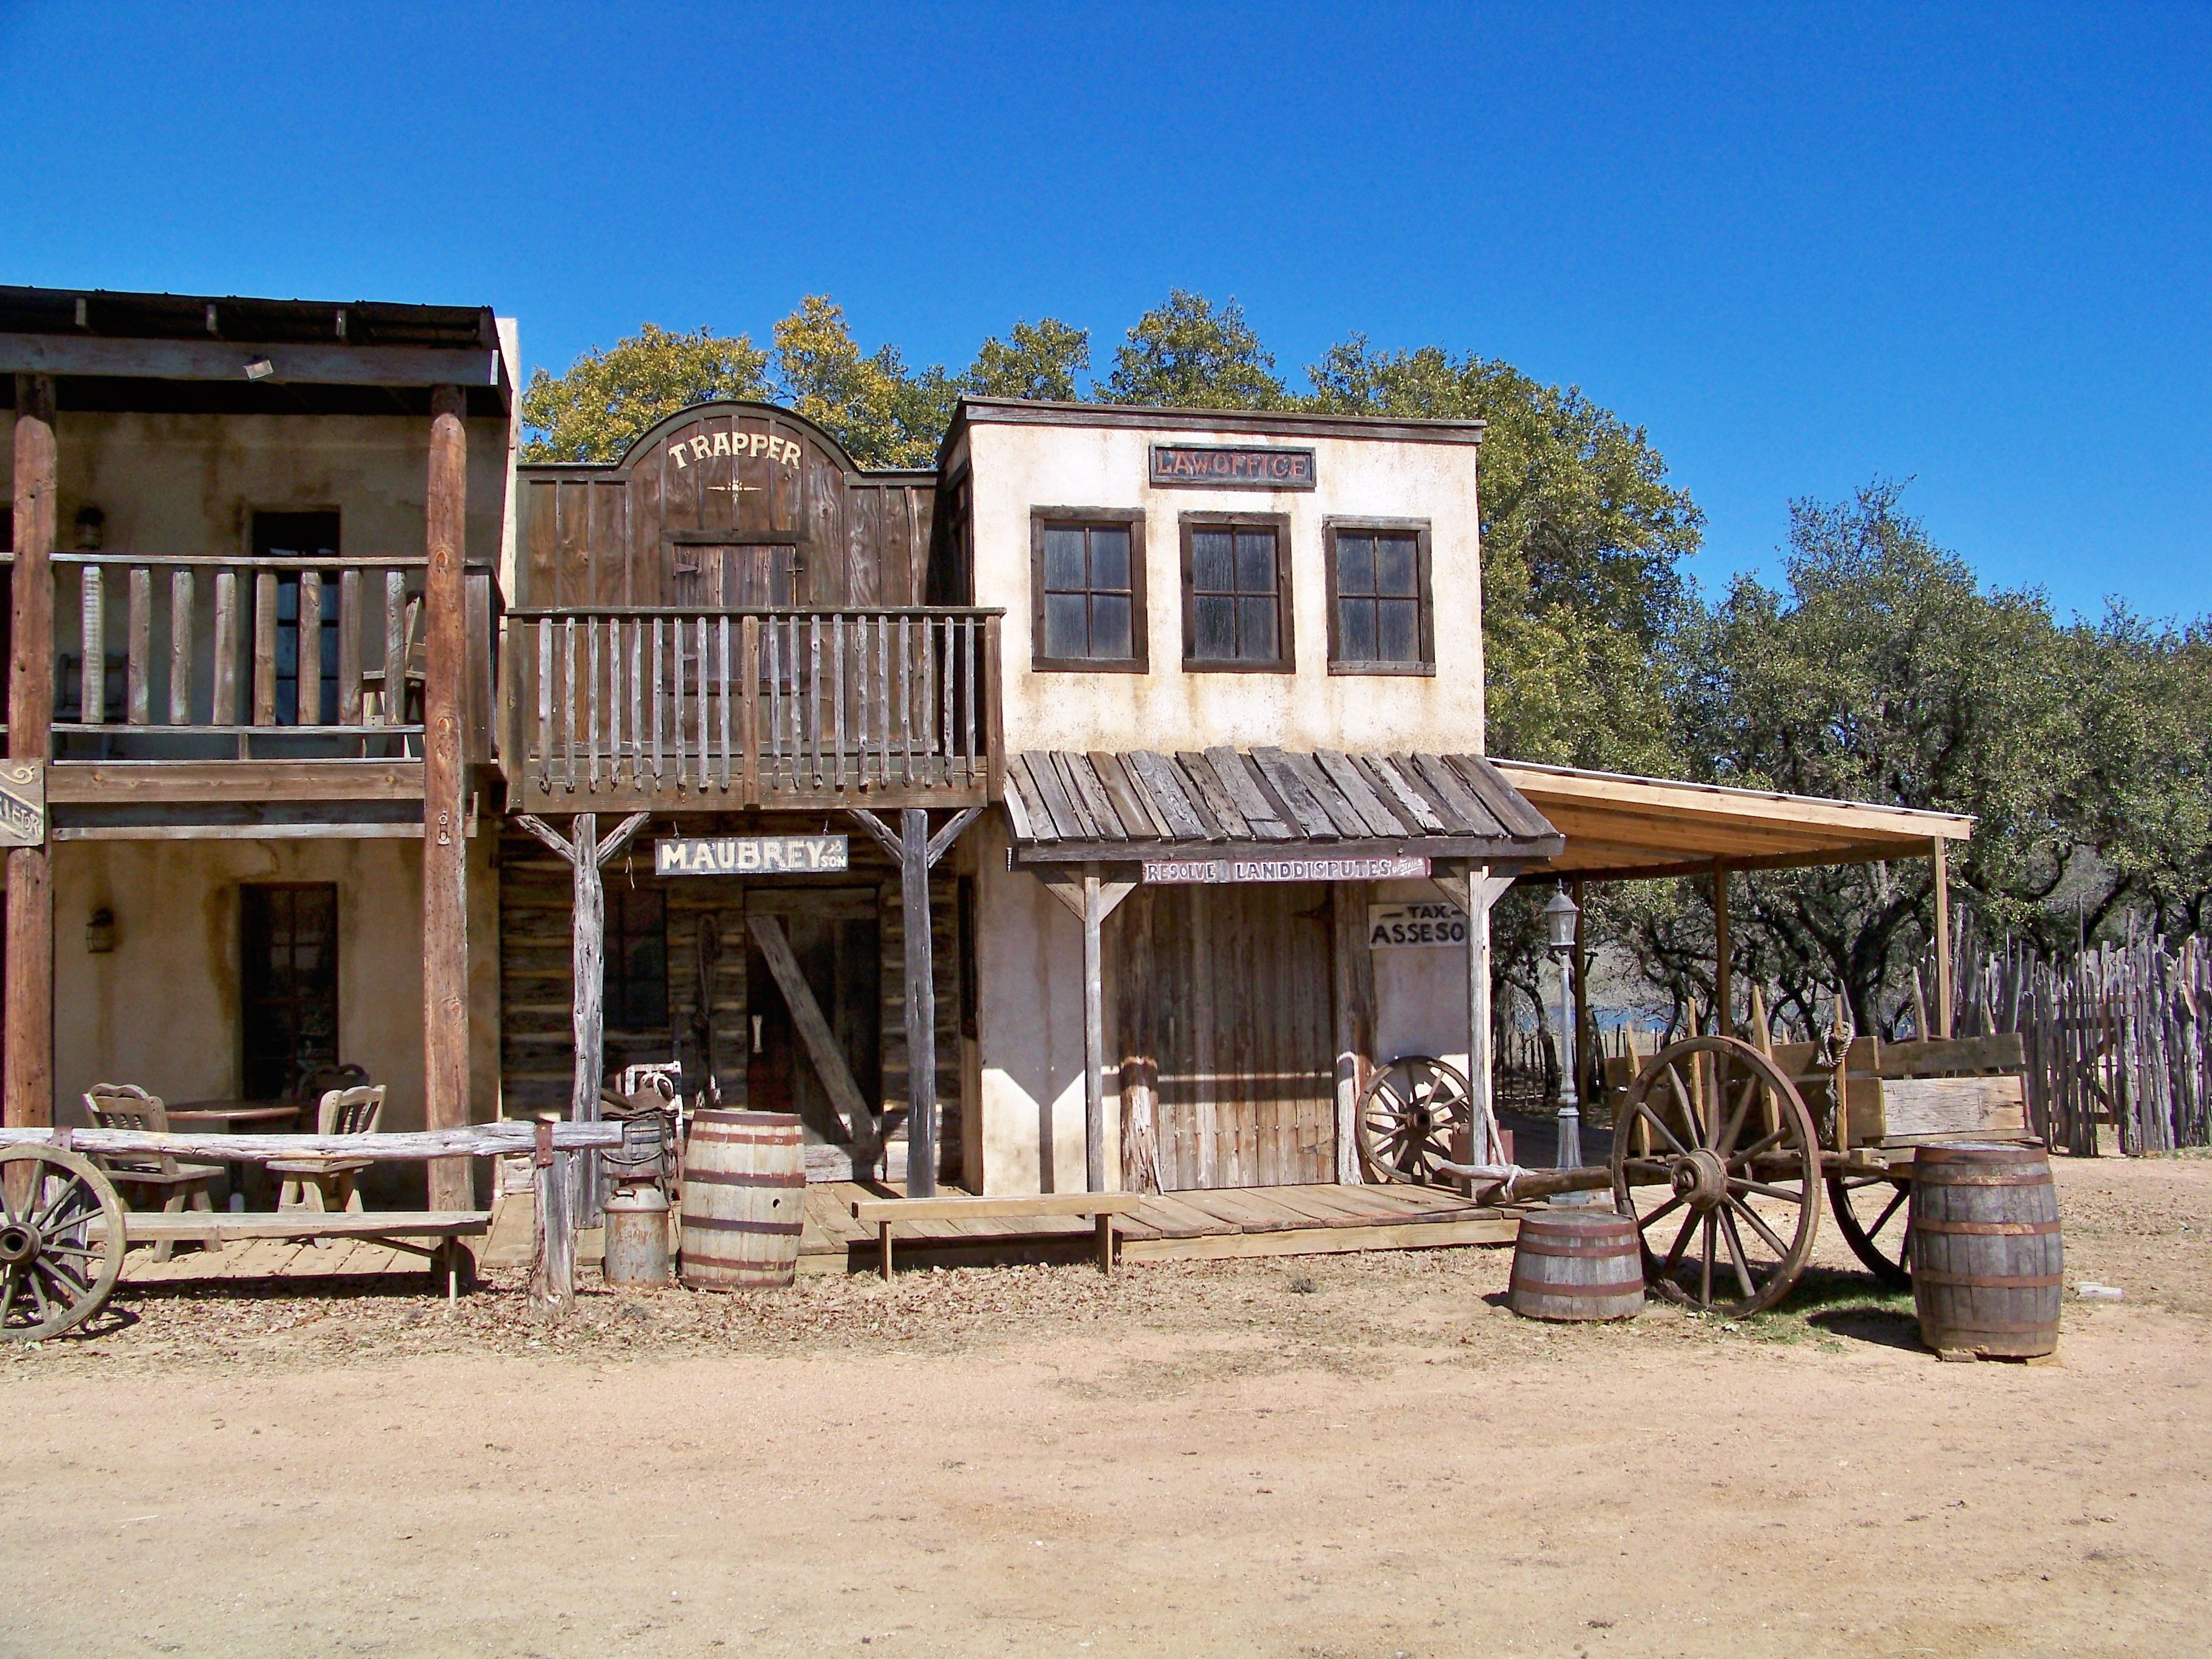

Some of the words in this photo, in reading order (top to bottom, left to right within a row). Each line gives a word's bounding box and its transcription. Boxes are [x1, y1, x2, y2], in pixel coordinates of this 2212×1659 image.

[668, 432, 802, 469] TRAPPER
[0, 794, 40, 836] IETOR
[820, 855, 846, 868] SON
[1145, 863, 1216, 880] RESOLVE
